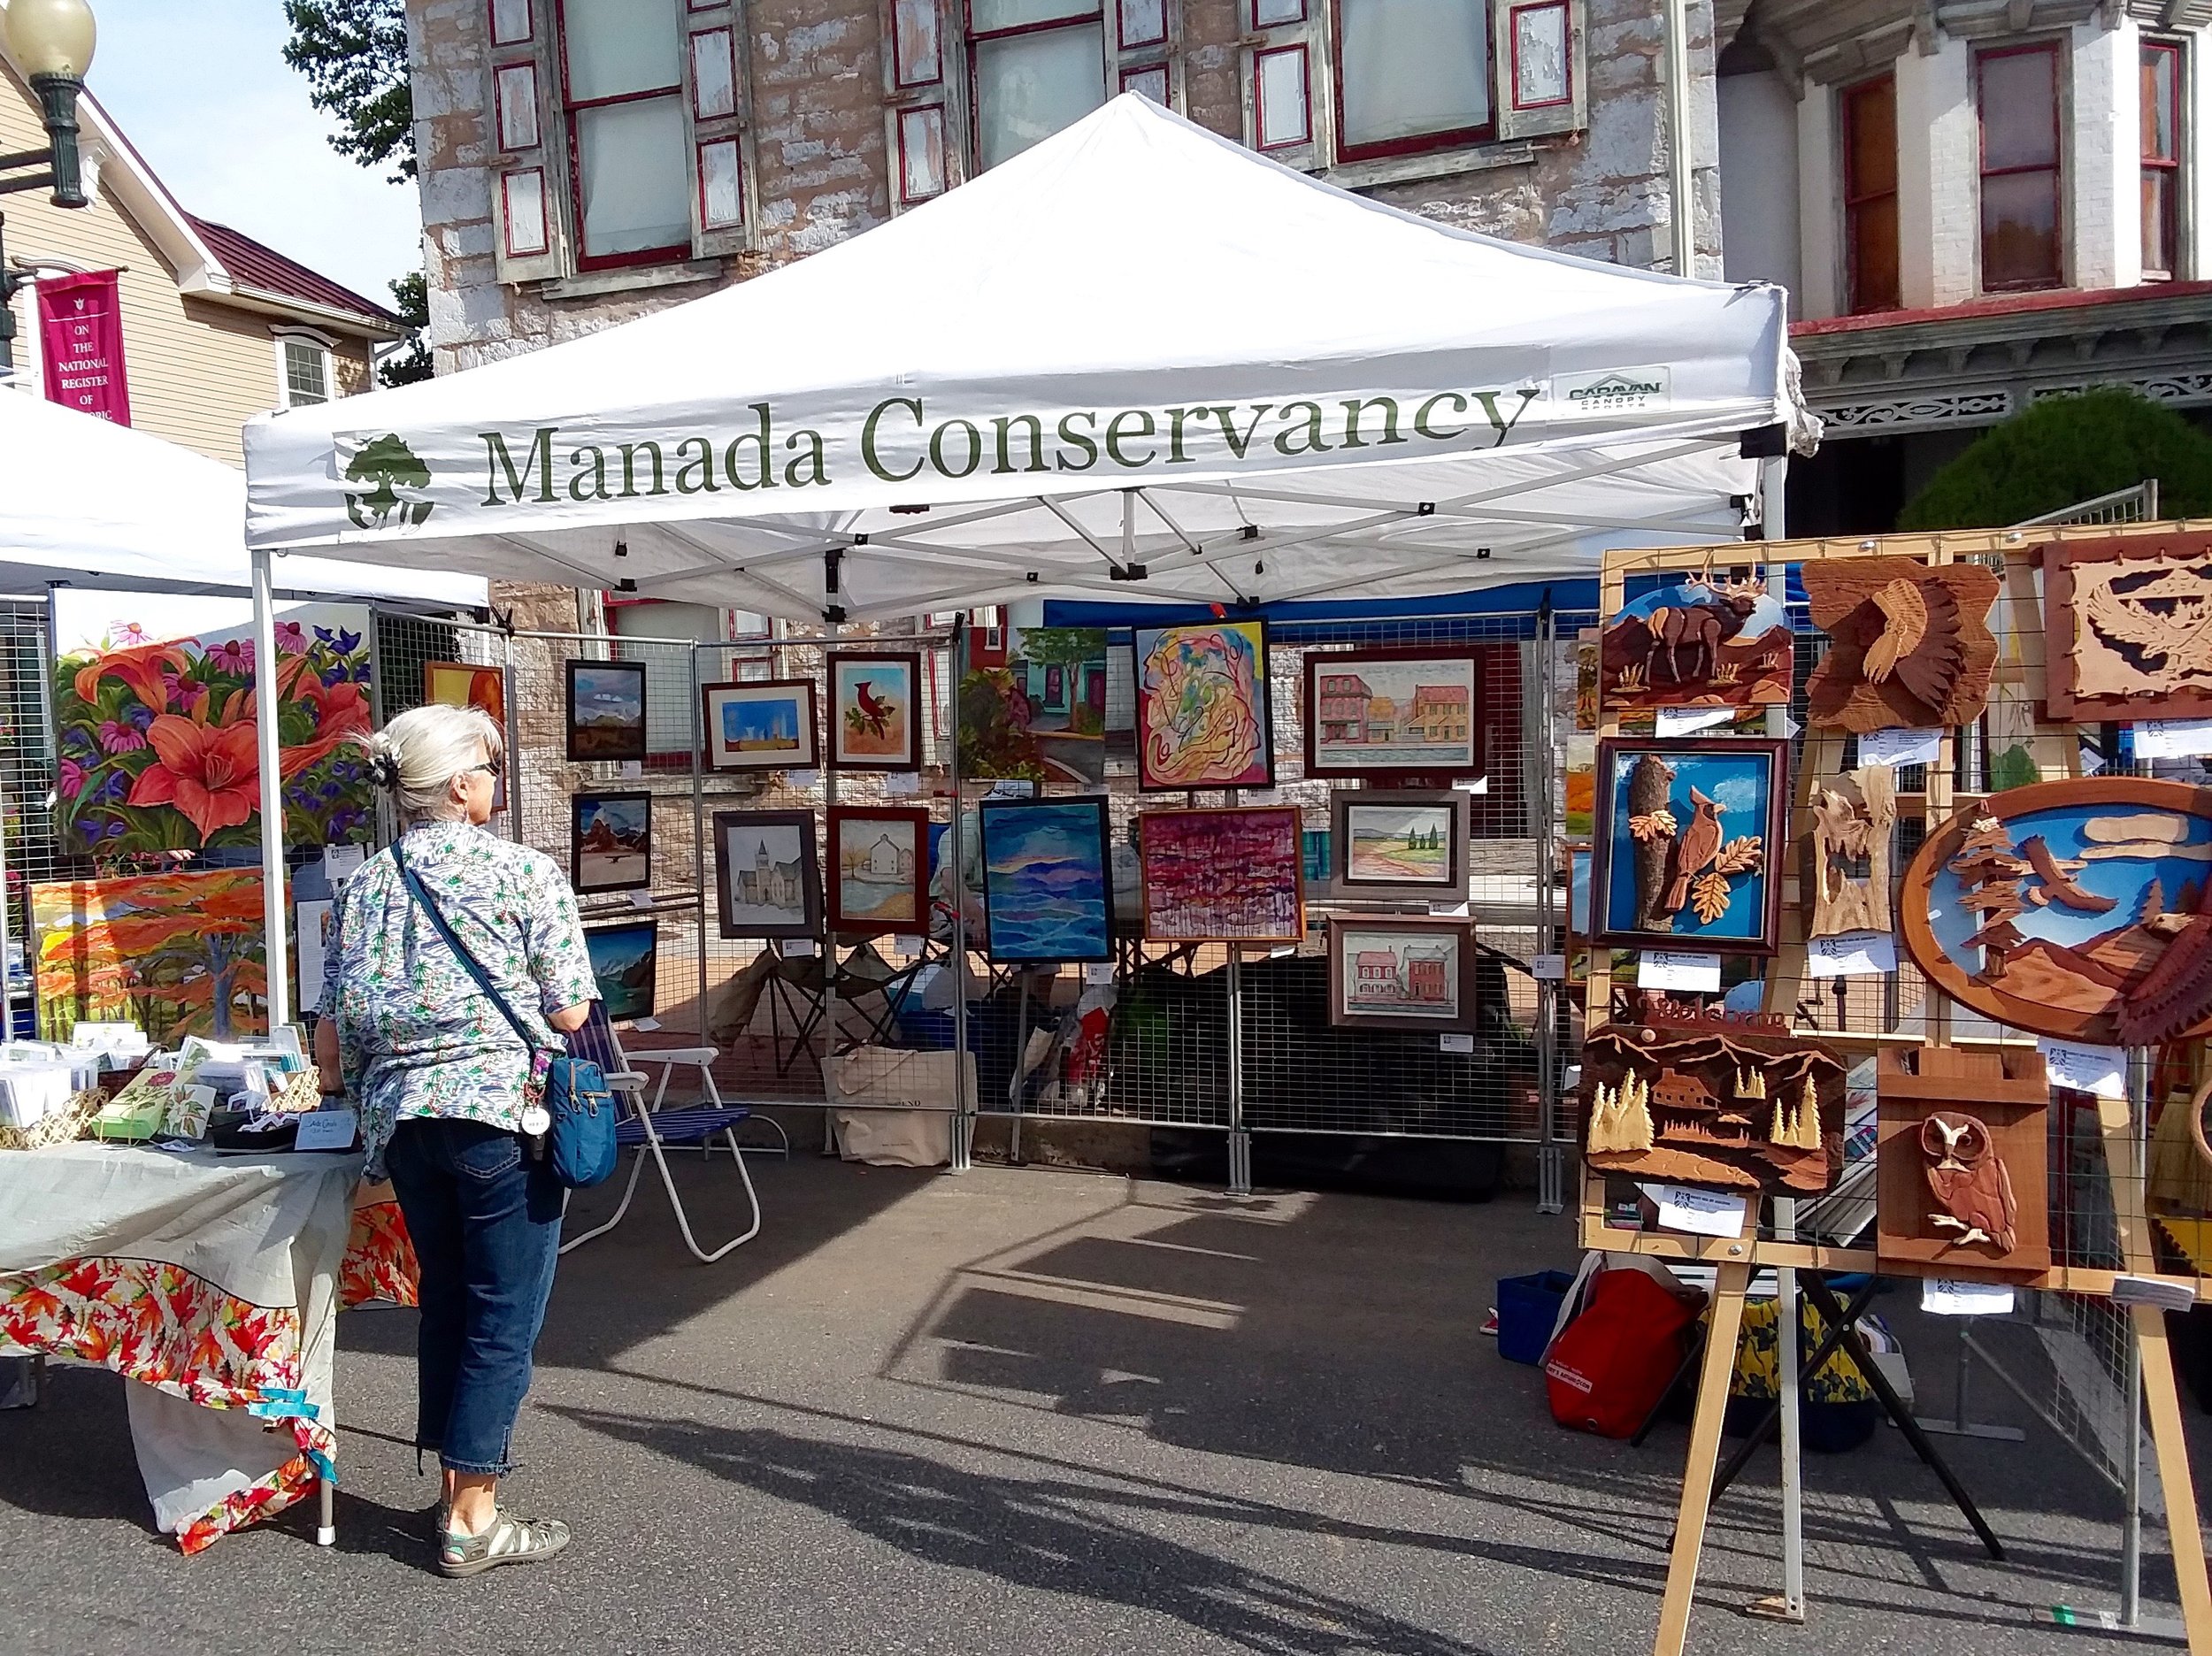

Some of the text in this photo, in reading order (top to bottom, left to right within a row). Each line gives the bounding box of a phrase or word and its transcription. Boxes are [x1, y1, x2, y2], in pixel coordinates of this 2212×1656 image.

[74, 324, 89, 336] ON
[73, 341, 95, 354] THE
[58, 357, 109, 372] NATIONAL
[61, 375, 109, 389] REGISTER
[79, 395, 94, 405] OF
[1582, 395, 1646, 406] CANOPY
[477, 388, 1541, 508] Manada Conservancy
